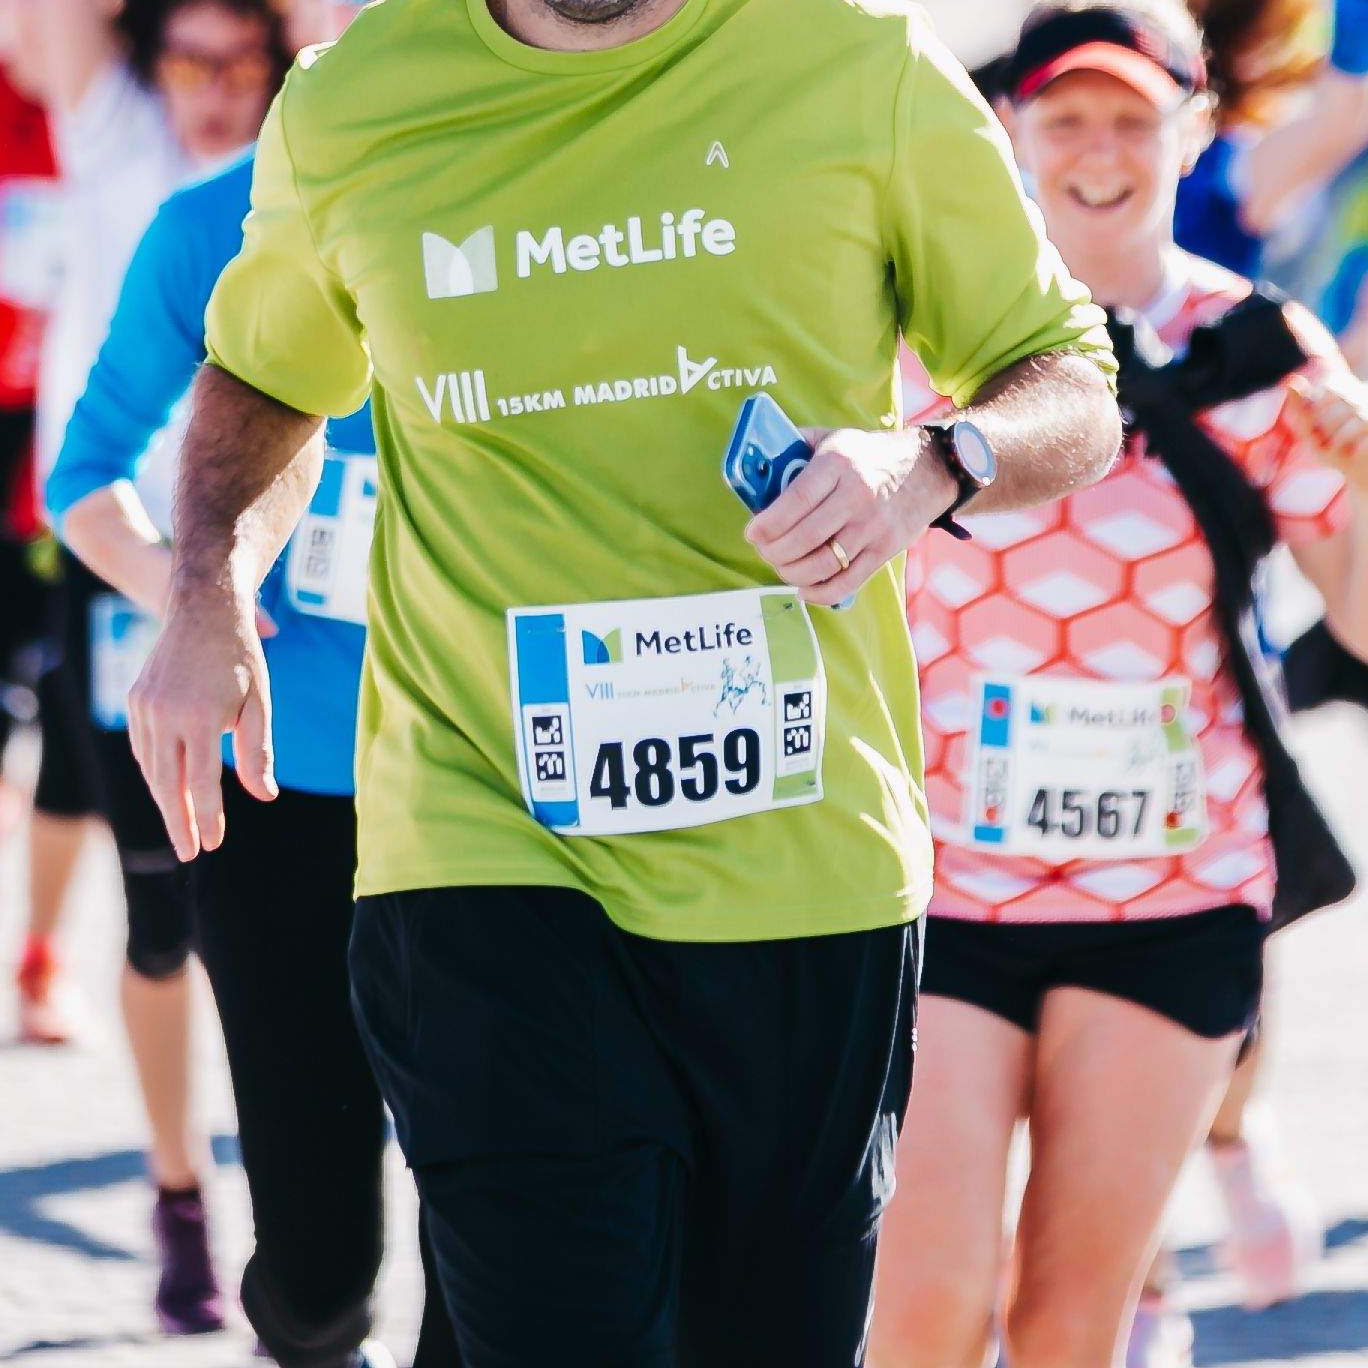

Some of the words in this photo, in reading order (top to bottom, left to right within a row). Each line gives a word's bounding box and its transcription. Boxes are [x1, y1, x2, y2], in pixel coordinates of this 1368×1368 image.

[516, 209, 736, 278] MetLife
[416, 369, 491, 423] VIII
[498, 389, 566, 417] 15KM
[635, 622, 753, 656] MetLife
[590, 728, 760, 810] 4859
[1027, 789, 1150, 838] 4567
